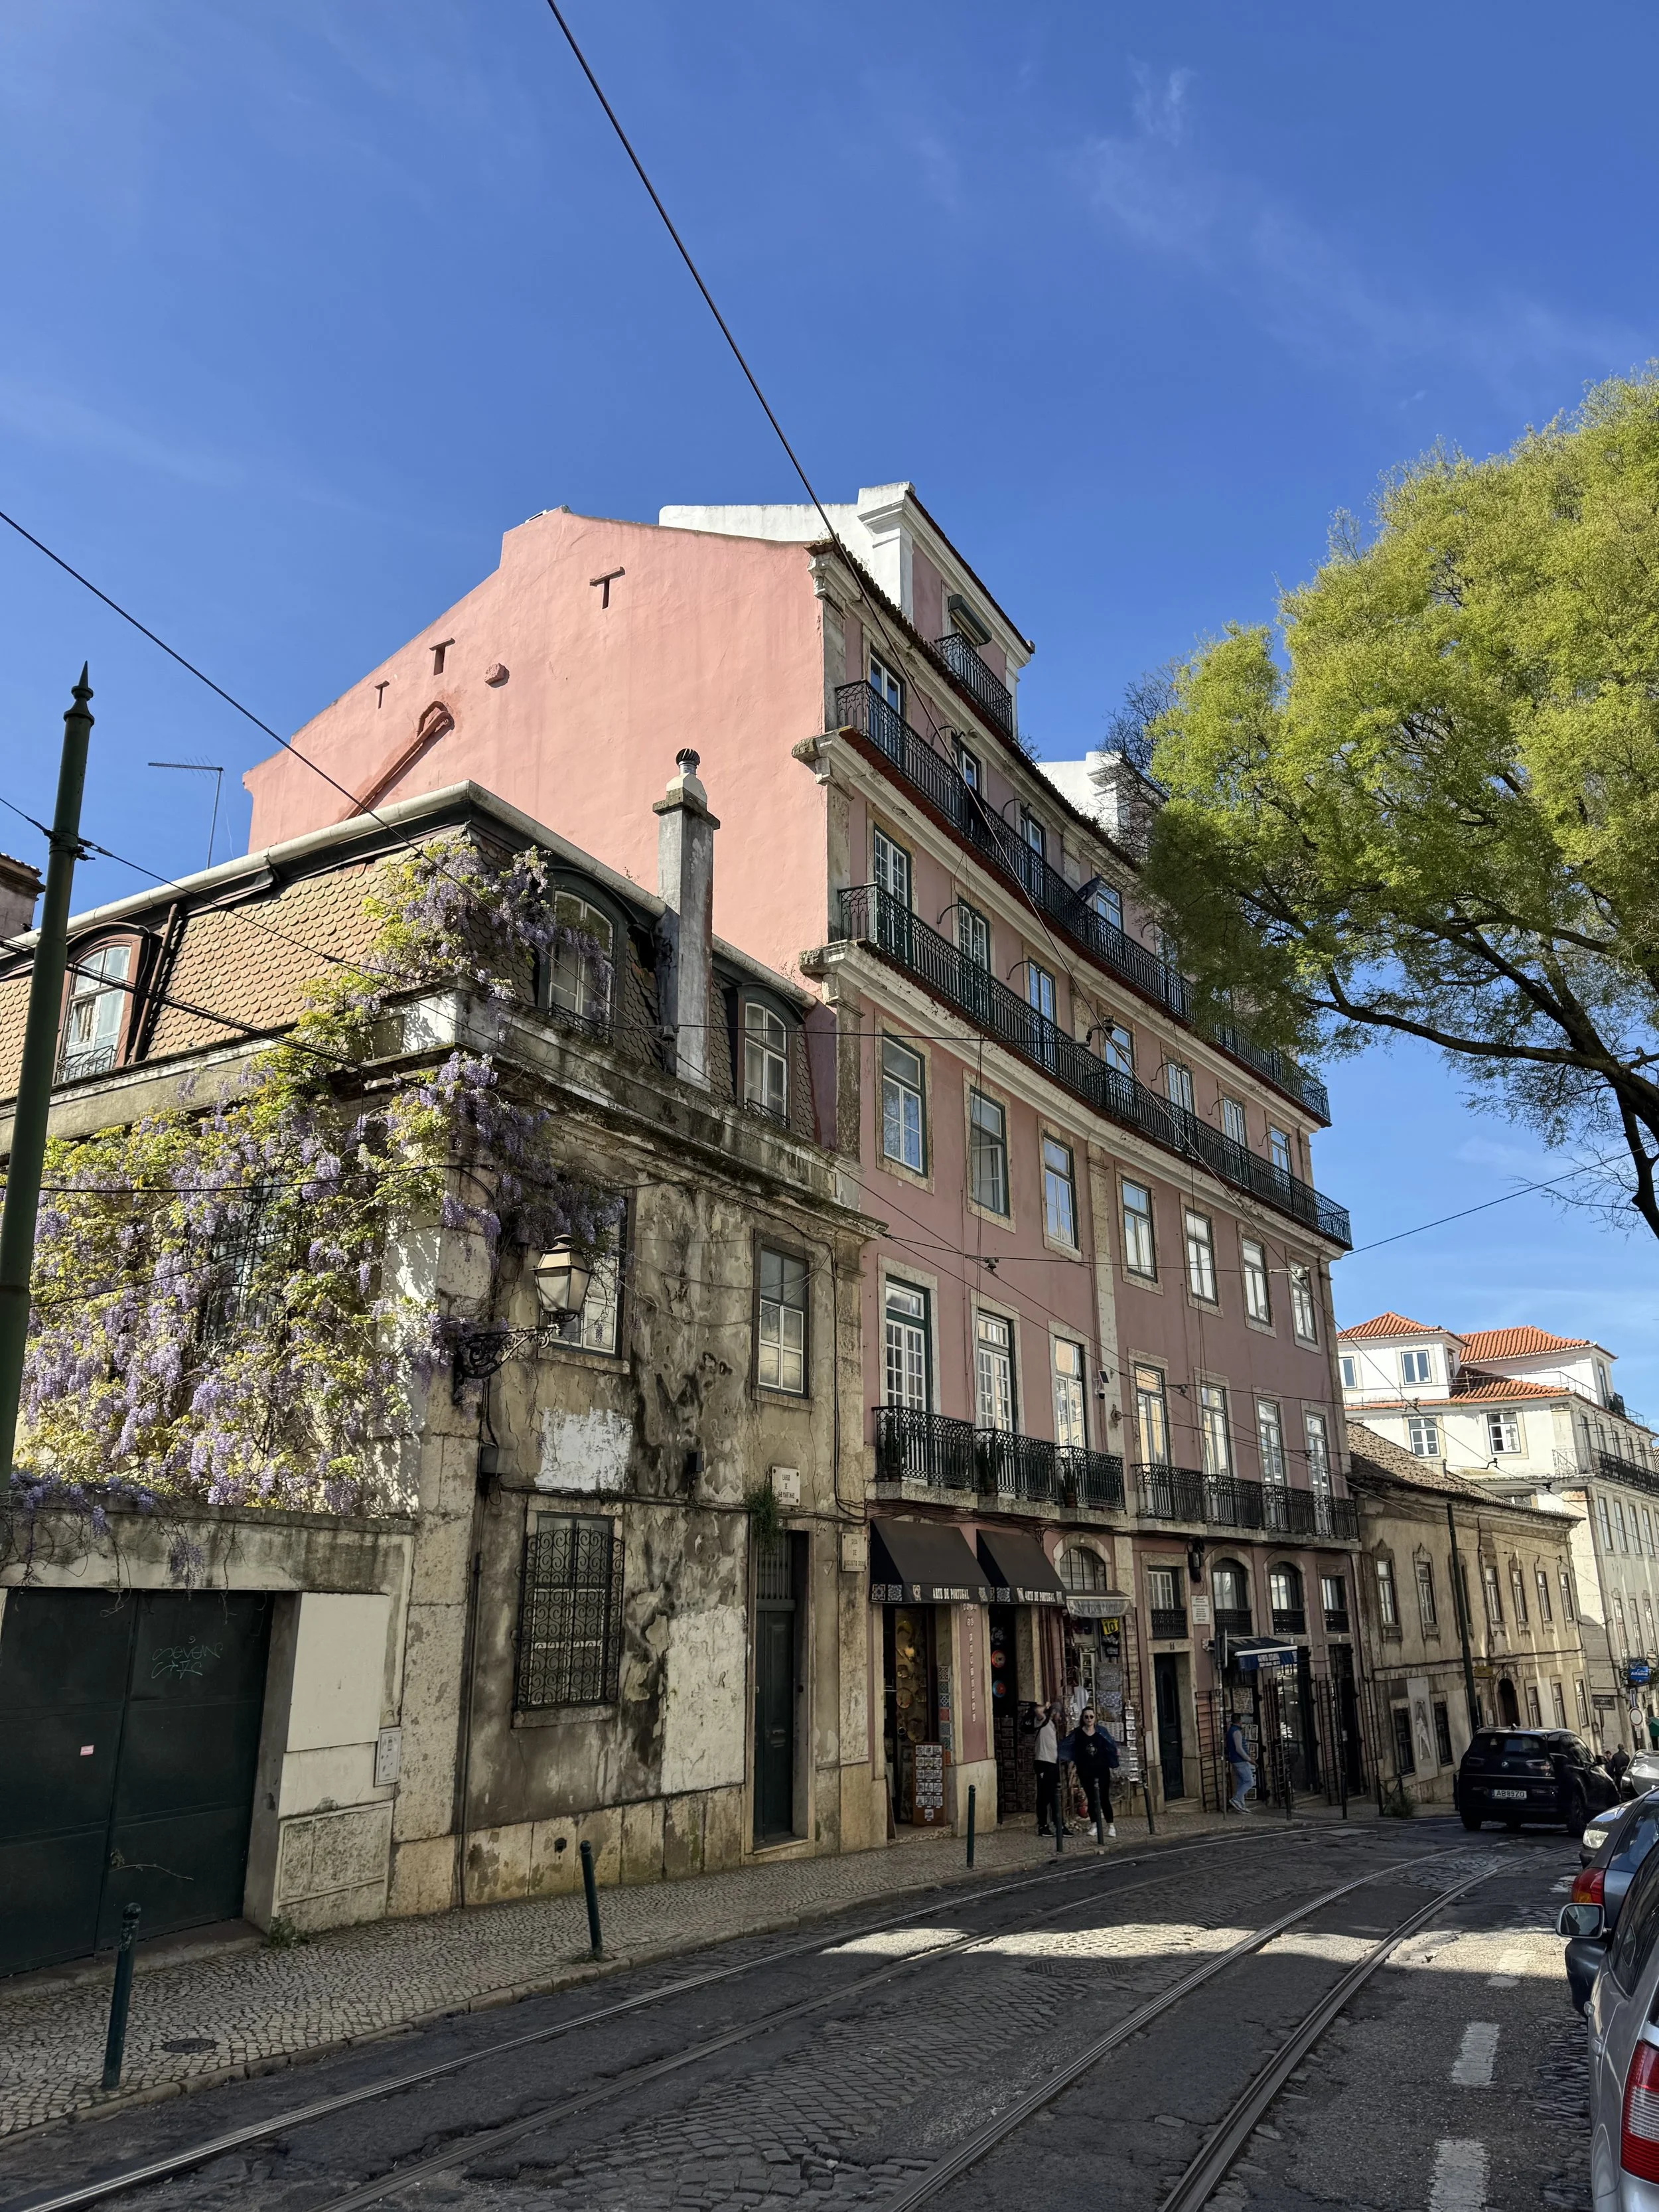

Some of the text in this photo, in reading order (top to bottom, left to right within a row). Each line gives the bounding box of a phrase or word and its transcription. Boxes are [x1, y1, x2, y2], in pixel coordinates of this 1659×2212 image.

[932, 1587, 970, 1600] ARTE DE PORTUGAL
[1025, 1590, 1056, 1602] ARTE DE PORTUGAL
[1104, 1622, 1115, 1633] 10
